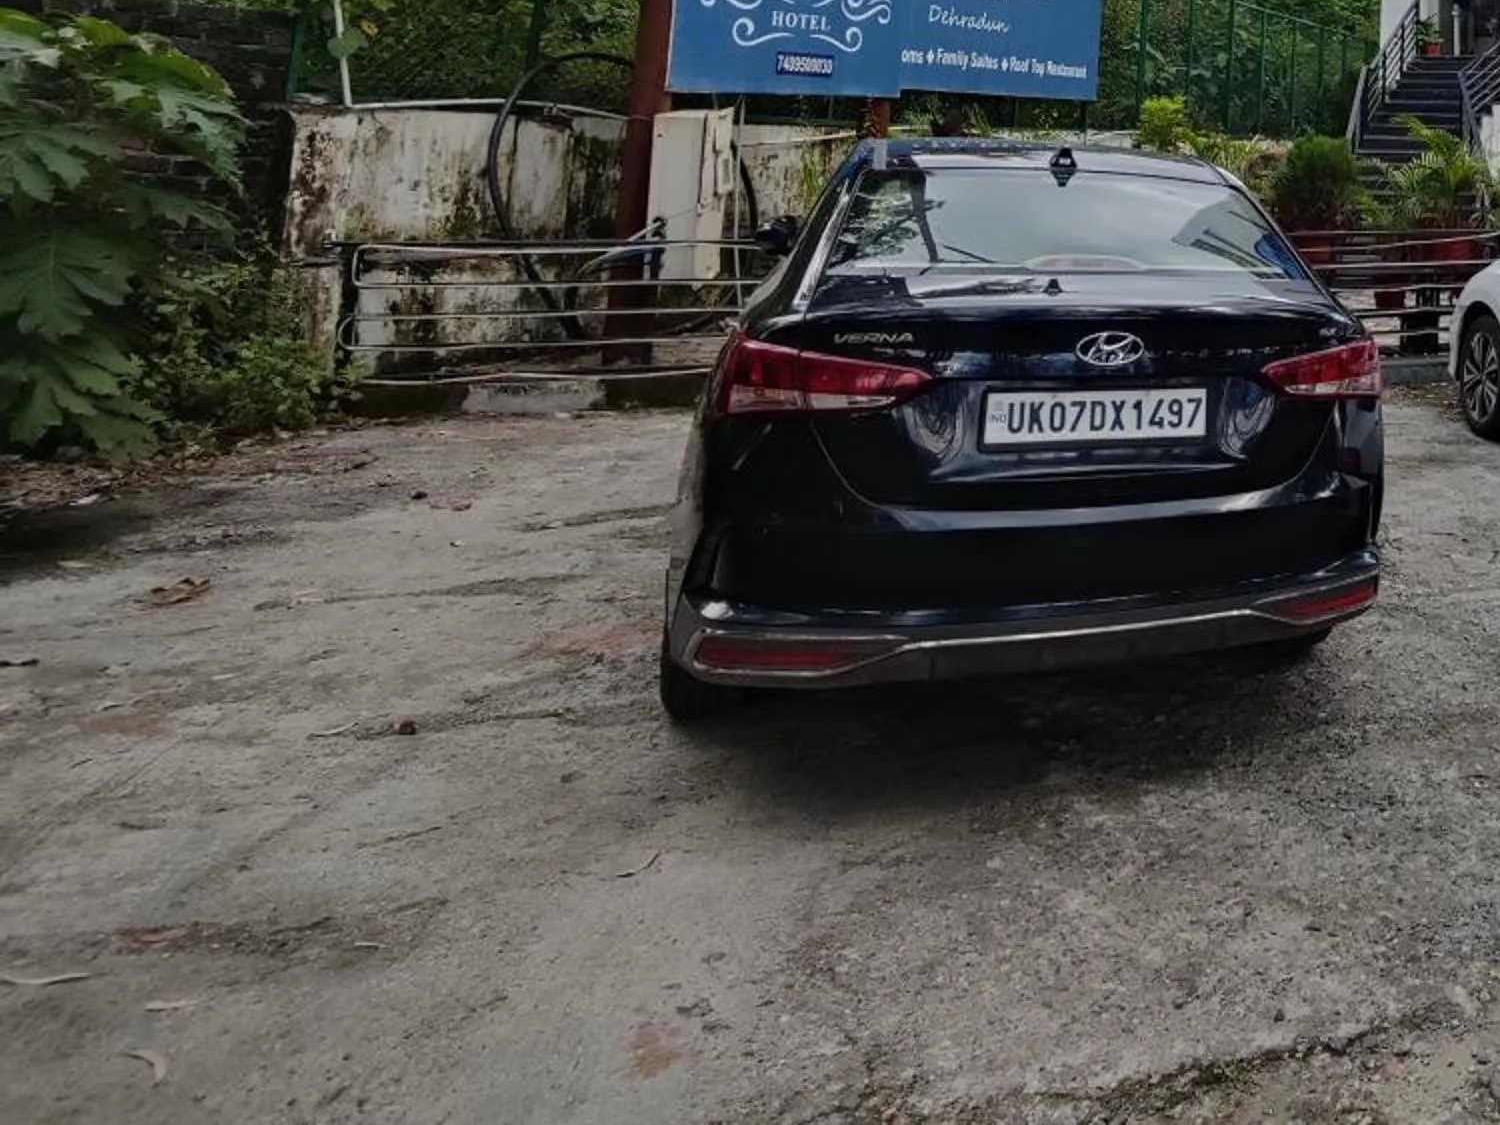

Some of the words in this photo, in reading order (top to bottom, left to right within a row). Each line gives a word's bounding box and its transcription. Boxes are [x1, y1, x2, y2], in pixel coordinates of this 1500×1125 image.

[771, 10, 832, 32] HOTEL
[928, 4, 1010, 33] Dehradun
[901, 49, 925, 64] oms
[935, 47, 969, 70] Family
[971, 51, 999, 70] Suites
[1009, 56, 1031, 73] Roof
[833, 332, 914, 345] VERNA
[1006, 398, 1203, 434] UK07DX1497
